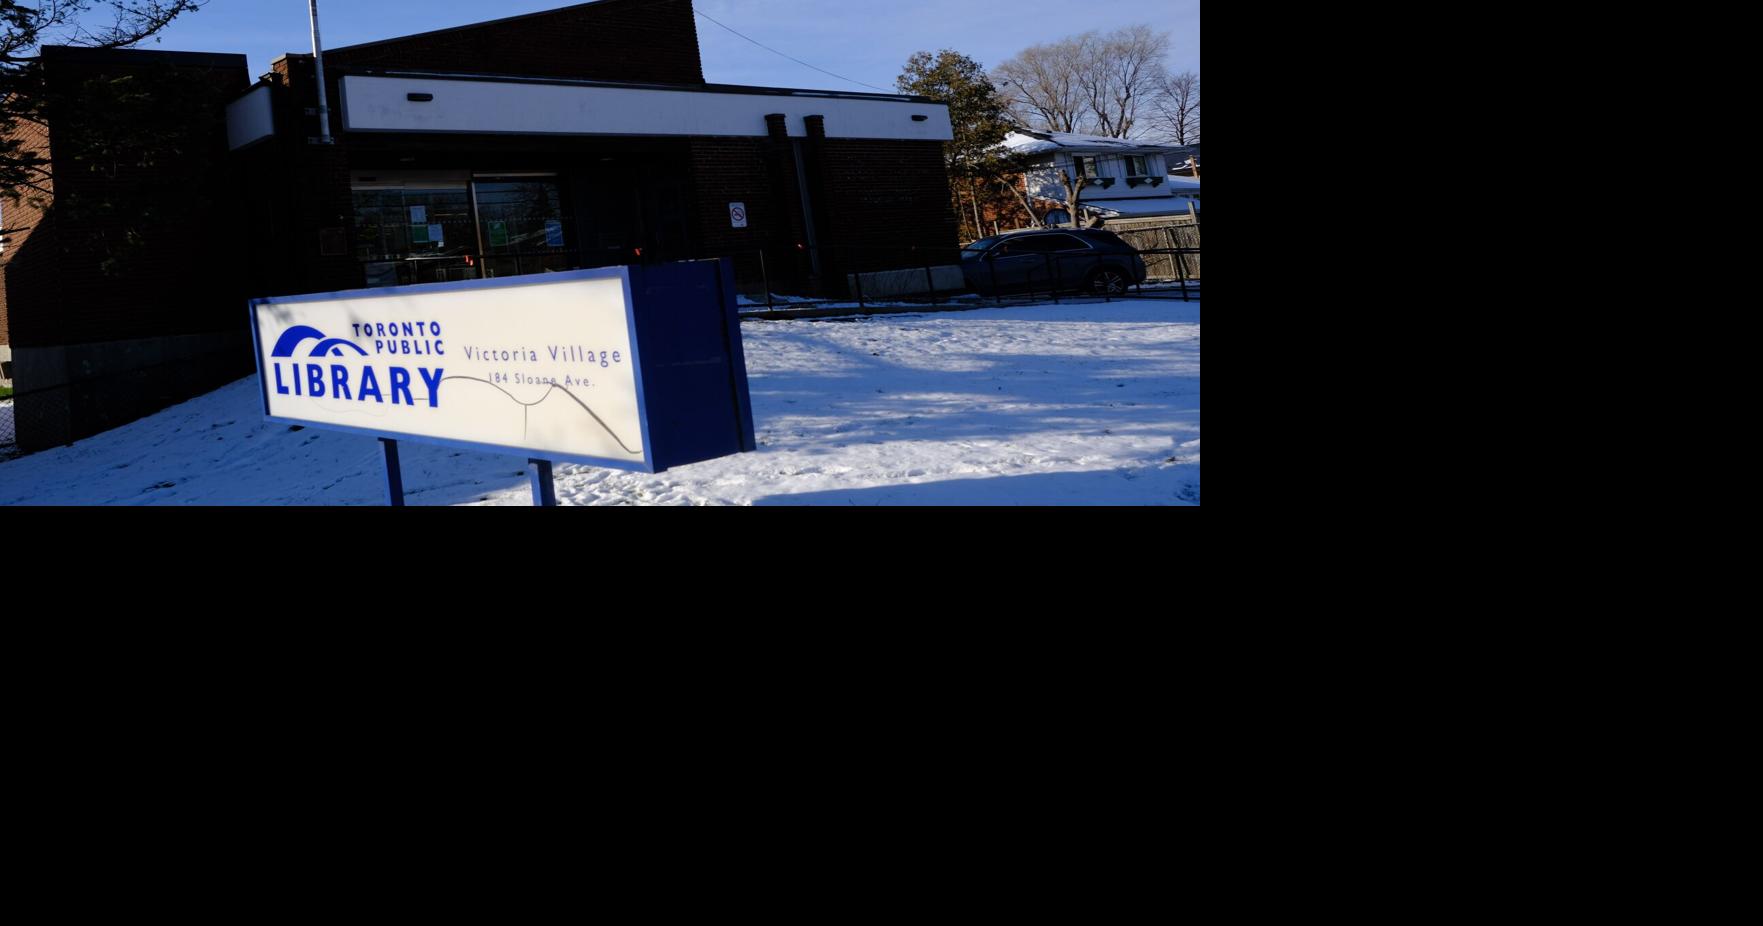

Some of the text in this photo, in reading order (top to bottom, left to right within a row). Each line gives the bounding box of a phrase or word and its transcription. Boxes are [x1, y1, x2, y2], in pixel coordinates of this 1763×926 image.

[352, 321, 441, 337] TORONTO
[375, 339, 445, 355] PUBLIC
[463, 345, 622, 368] Victoria Village
[273, 362, 444, 408] LIBRARY
[488, 372, 596, 387] 184 Sloane Ave.
